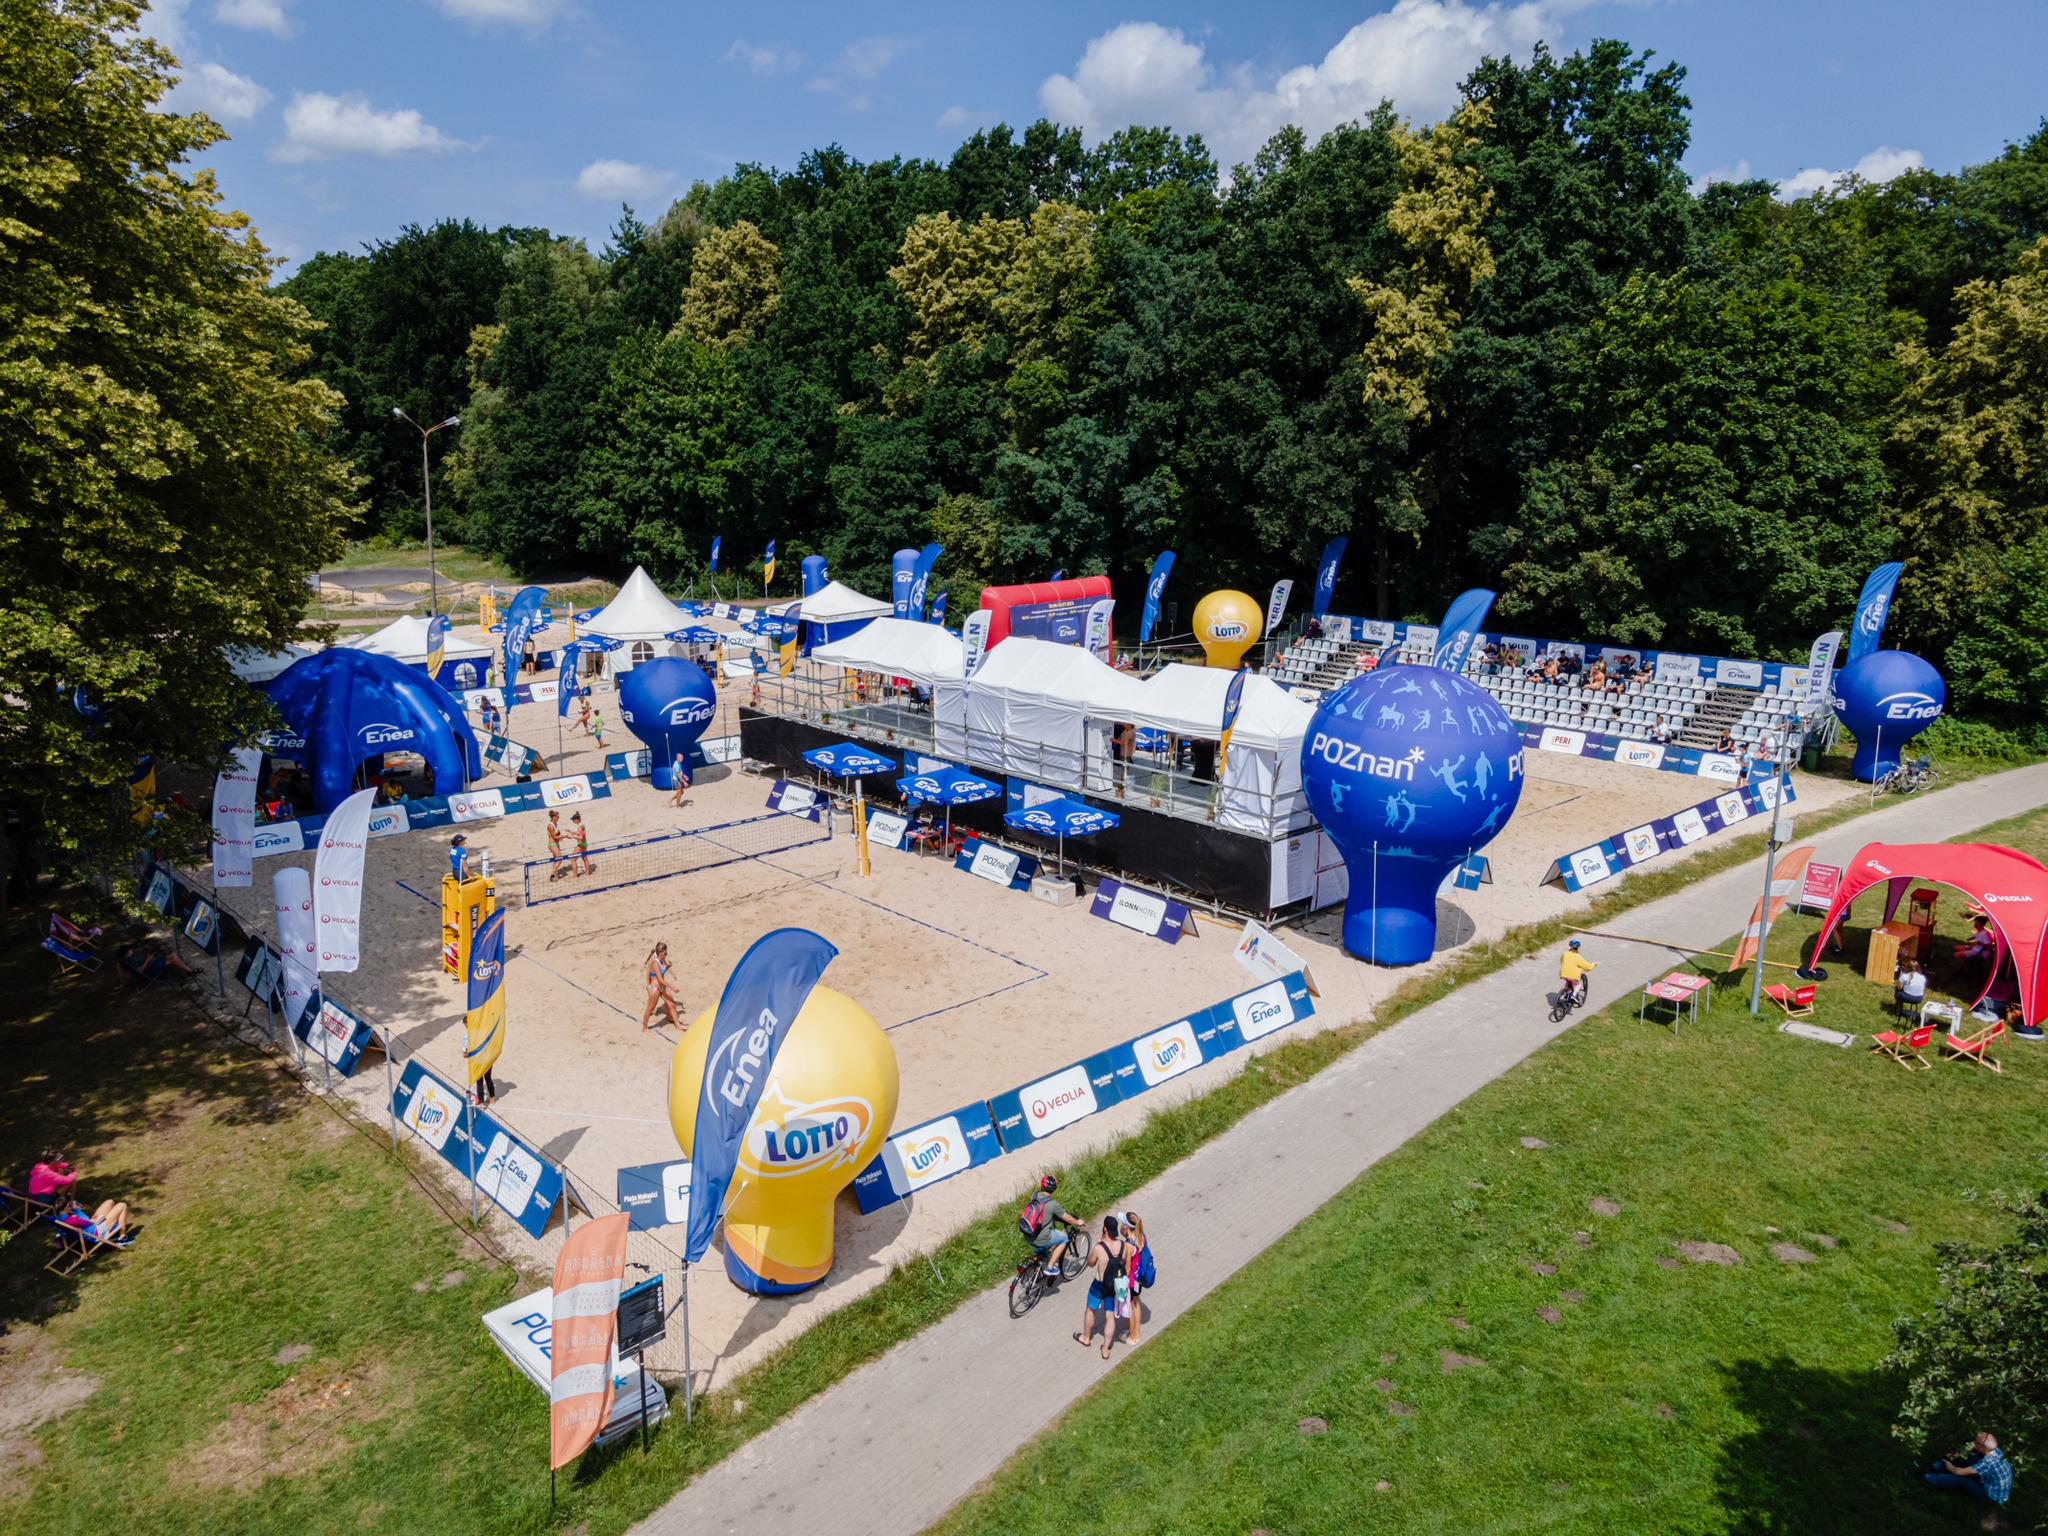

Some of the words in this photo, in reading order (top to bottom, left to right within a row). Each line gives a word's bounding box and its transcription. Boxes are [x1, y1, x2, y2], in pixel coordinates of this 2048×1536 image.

[1325, 560, 1337, 588] Enea
[913, 571, 928, 607] Enea
[1270, 586, 1285, 626] TERLAN
[1868, 593, 1886, 632] Enea
[513, 616, 530, 655] Enea
[1215, 626, 1240, 638] LOTTO
[965, 623, 981, 678] ERLAN
[1508, 642, 1530, 650] SOLID
[1728, 671, 1750, 680] Enea
[1810, 642, 1830, 695] TERLAN
[566, 664, 576, 690] Enea
[541, 687, 555, 695] PERI
[671, 705, 716, 725] Enea
[1887, 703, 1942, 719] Enea
[266, 735, 306, 748] Enea
[366, 729, 414, 744] Enea
[1555, 736, 1571, 745] PERI
[1629, 752, 1650, 760] LOTTO
[1711, 763, 1739, 776] Enea
[557, 786, 578, 800] LOTTO
[914, 781, 942, 794] Enea
[956, 783, 987, 793] Enea
[468, 800, 497, 810] VEOLIA
[369, 817, 392, 832] LOTTO
[1024, 814, 1056, 826] Enea
[1070, 813, 1104, 825] Enea
[255, 837, 290, 849] Enea
[335, 841, 362, 849] VEOLIA
[1583, 861, 1601, 875] Enea
[1875, 863, 1891, 875] VEOLIA
[1252, 1004, 1281, 1024] Enea
[720, 1007, 778, 1107] Enea
[1156, 1042, 1179, 1065] LOTTO
[1047, 1087, 1085, 1110] VEOLIA
[419, 1103, 443, 1125] LOTTO
[765, 1116, 848, 1162] LOTTO
[912, 1142, 941, 1171] LOTTO
[508, 1160, 528, 1182] Enea
